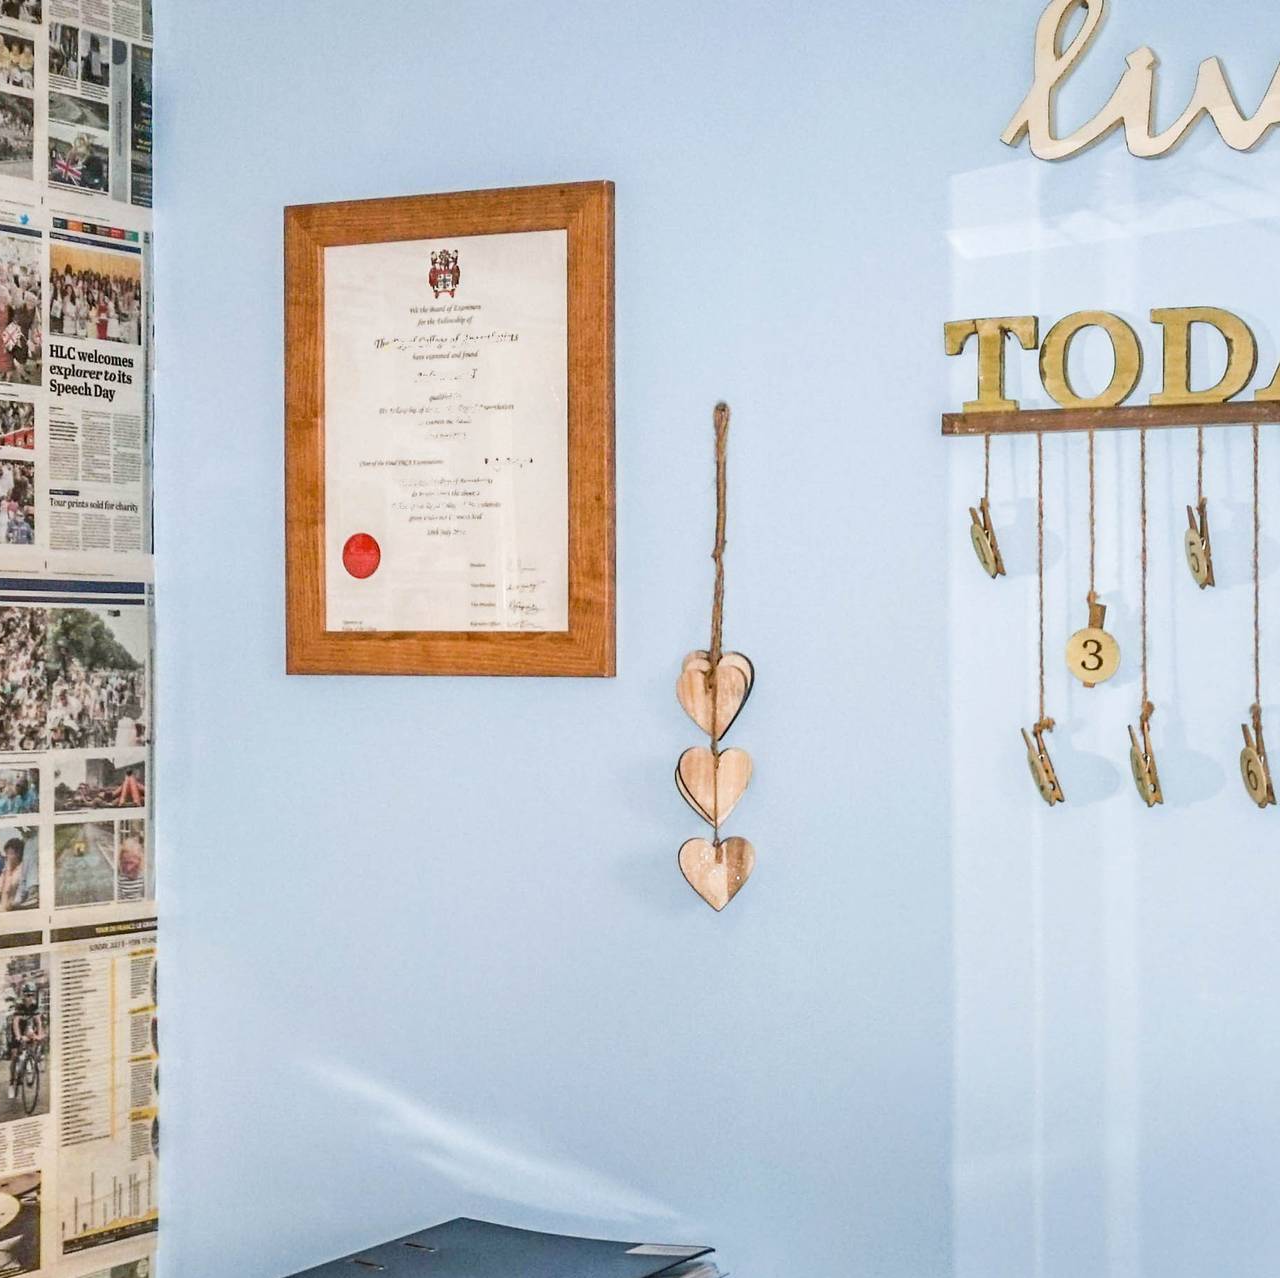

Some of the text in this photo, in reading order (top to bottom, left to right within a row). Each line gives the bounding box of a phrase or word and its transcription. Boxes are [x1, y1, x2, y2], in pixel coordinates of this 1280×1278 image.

[49, 344, 134, 368] HLC welcomes
[49, 362, 132, 385] explorer to its
[49, 379, 116, 402] Speech Day
[49, 497, 66, 508] Tour
[89, 498, 104, 509] sold
[104, 499, 114, 511] for
[1081, 638, 1104, 671] 3
[1246, 757, 1259, 791] 6
